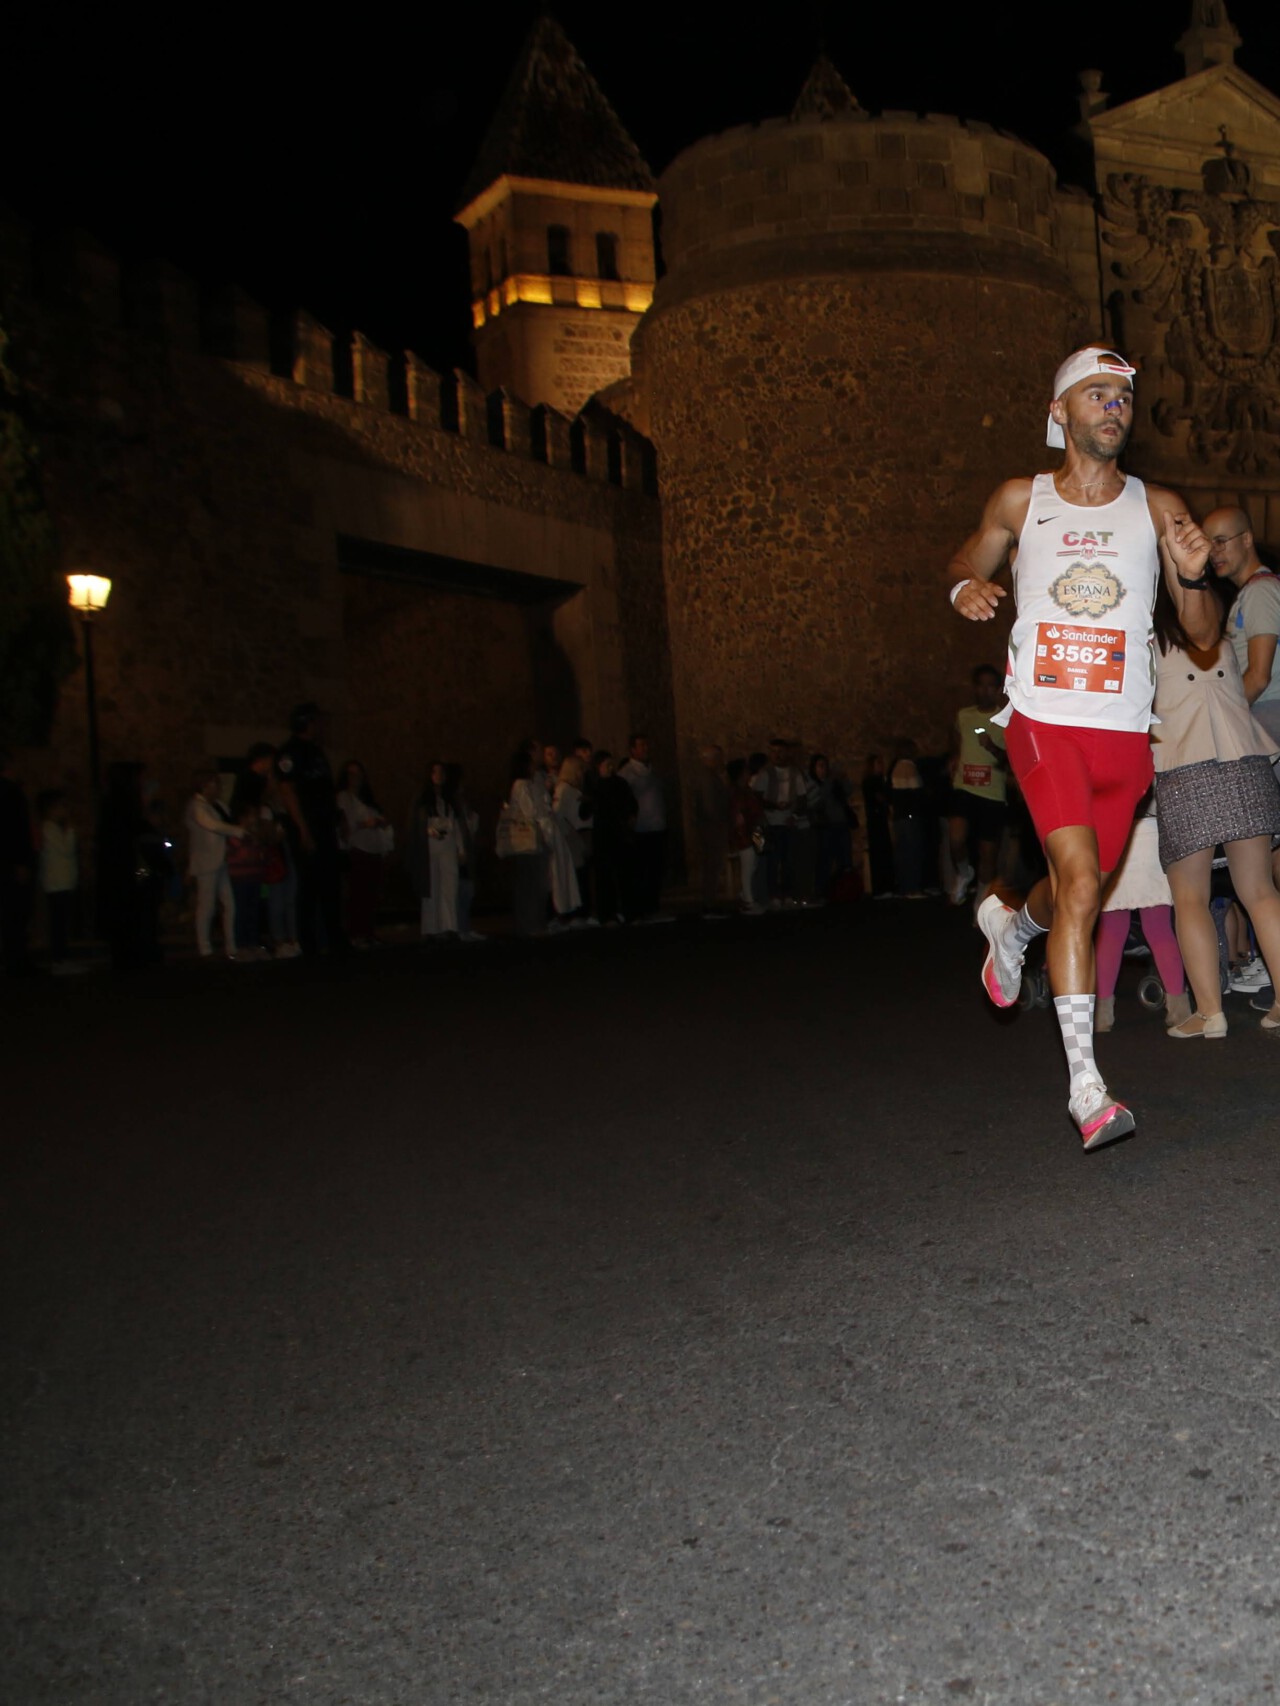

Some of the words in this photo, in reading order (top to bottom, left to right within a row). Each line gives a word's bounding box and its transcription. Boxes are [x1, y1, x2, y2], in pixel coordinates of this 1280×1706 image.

[1062, 531, 1113, 546] CAT
[1063, 583, 1111, 597] ESPAÑA
[1062, 629, 1118, 644] Santander
[1051, 643, 1108, 665] 3562
